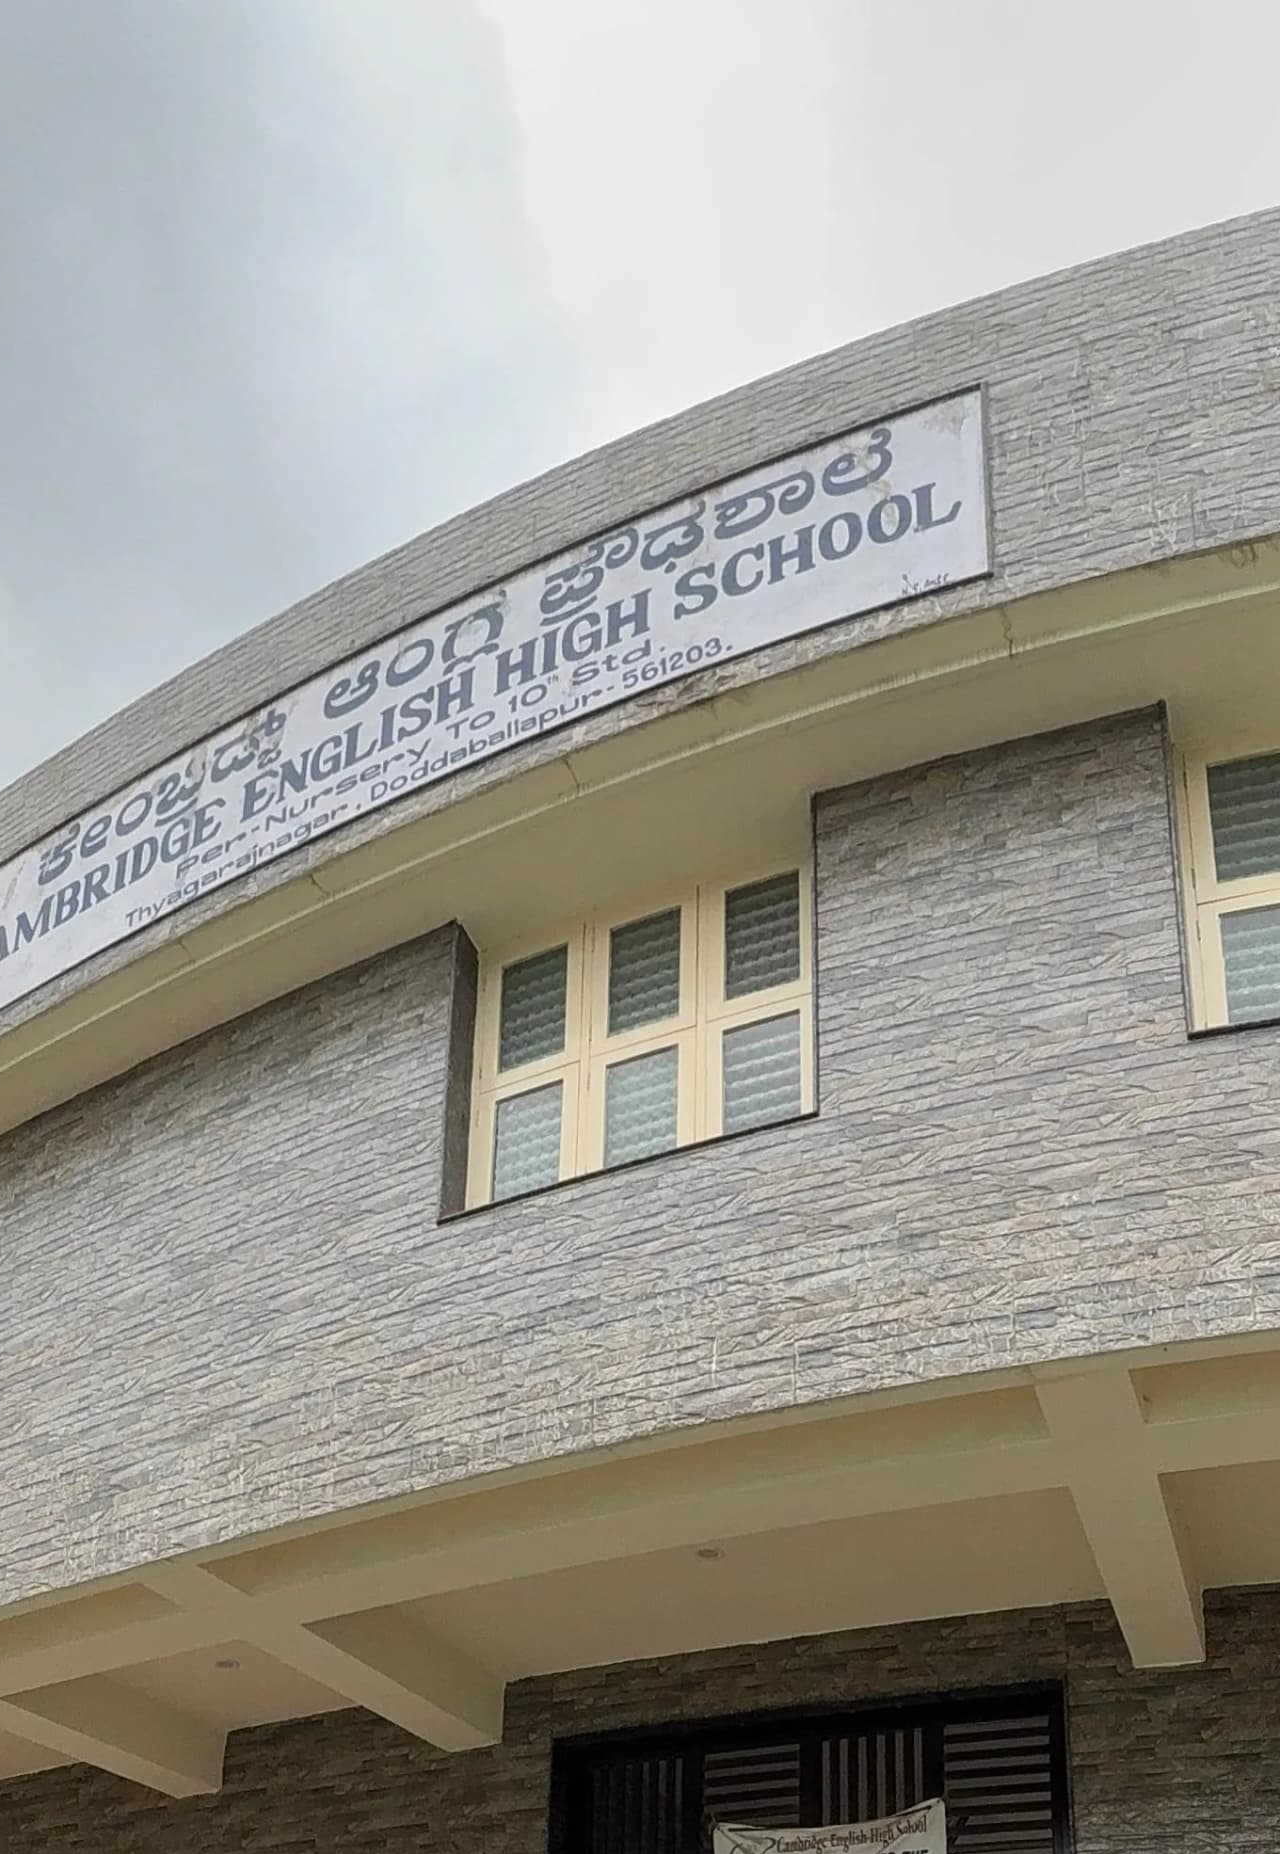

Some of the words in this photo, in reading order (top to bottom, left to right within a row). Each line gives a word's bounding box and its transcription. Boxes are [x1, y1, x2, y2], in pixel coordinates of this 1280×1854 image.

[240, 667, 477, 823] ENGLISH
[494, 588, 652, 697] HIGH
[673, 482, 963, 621] SCHOOL
